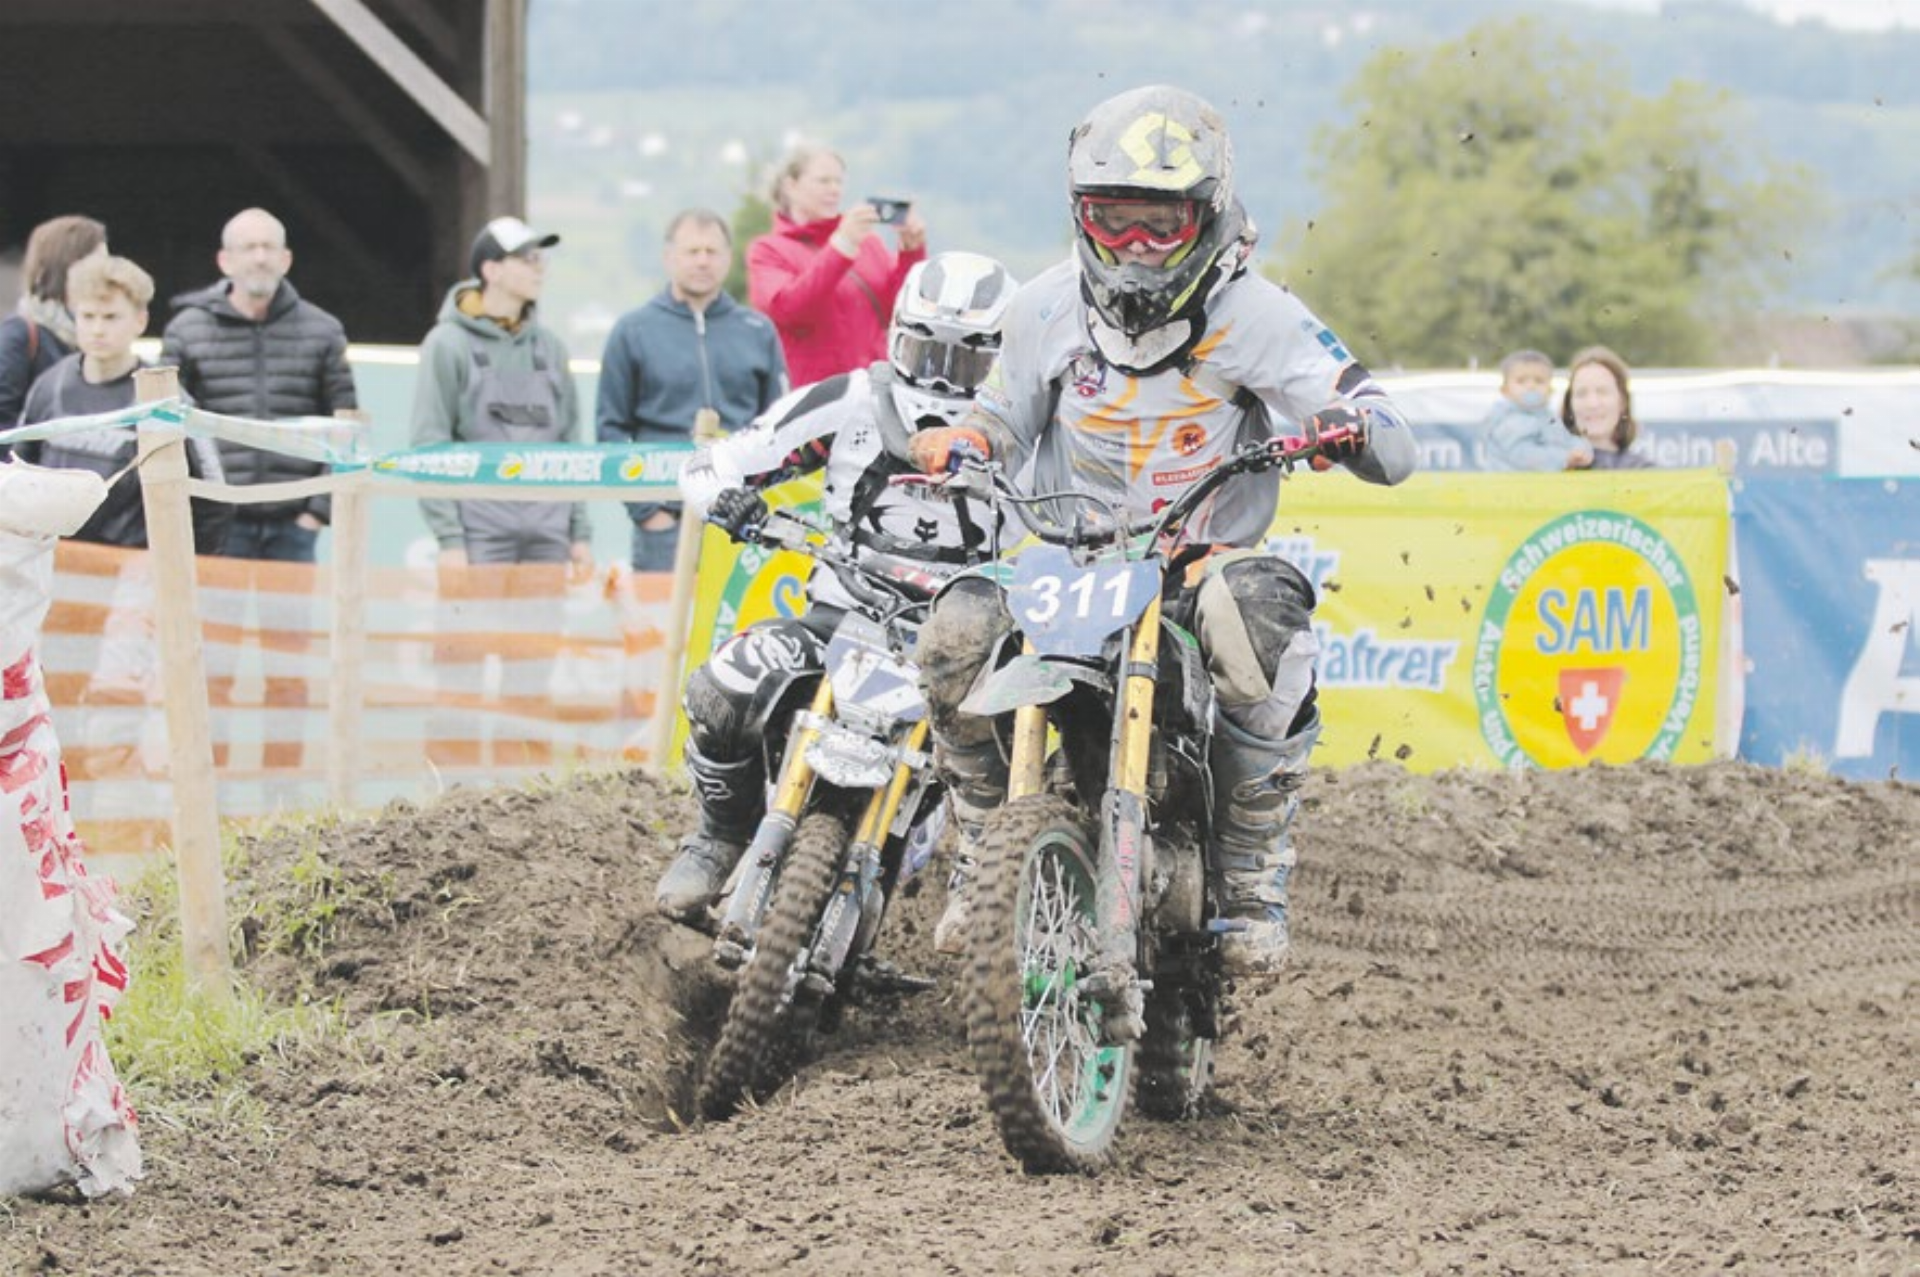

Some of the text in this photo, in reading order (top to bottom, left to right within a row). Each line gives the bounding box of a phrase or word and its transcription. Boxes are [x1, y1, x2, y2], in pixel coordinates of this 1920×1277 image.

[1752, 431, 1828, 466] Alte
[1501, 515, 1684, 593] Schweizerischer
[1025, 570, 1132, 623] 311
[1536, 586, 1651, 654] SAM
